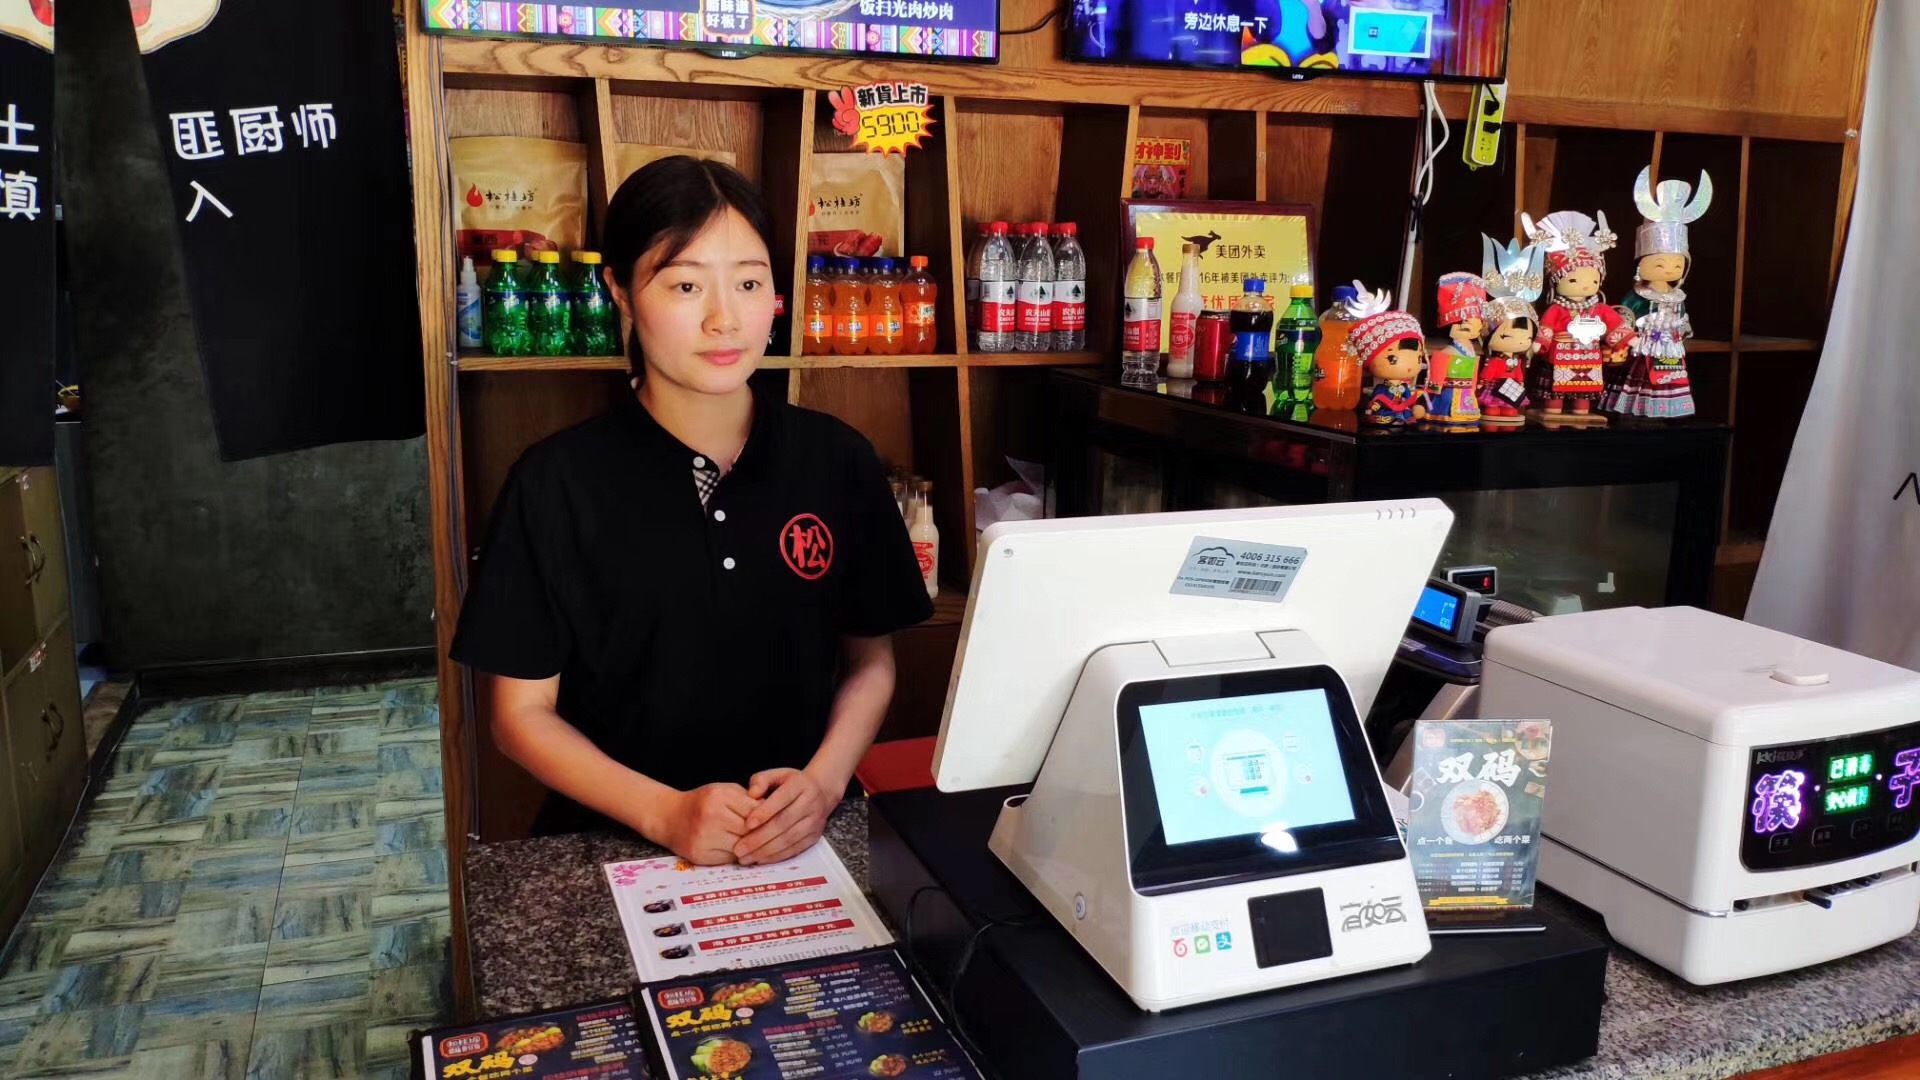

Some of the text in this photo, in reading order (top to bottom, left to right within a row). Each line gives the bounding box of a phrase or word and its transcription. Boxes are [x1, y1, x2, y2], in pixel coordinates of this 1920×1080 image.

[706, 13, 750, 30] 好极了
[1184, 12, 1268, 35] 旁边休息一下
[857, 85, 926, 108] 新貨上市
[169, 103, 337, 160] 匪厨师
[185, 180, 234, 222] 入
[1215, 244, 1266, 259] 美团外卖
[788, 524, 827, 569] 松
[1240, 551, 1301, 565] 4006 315 666
[1436, 750, 1522, 788] 双码
